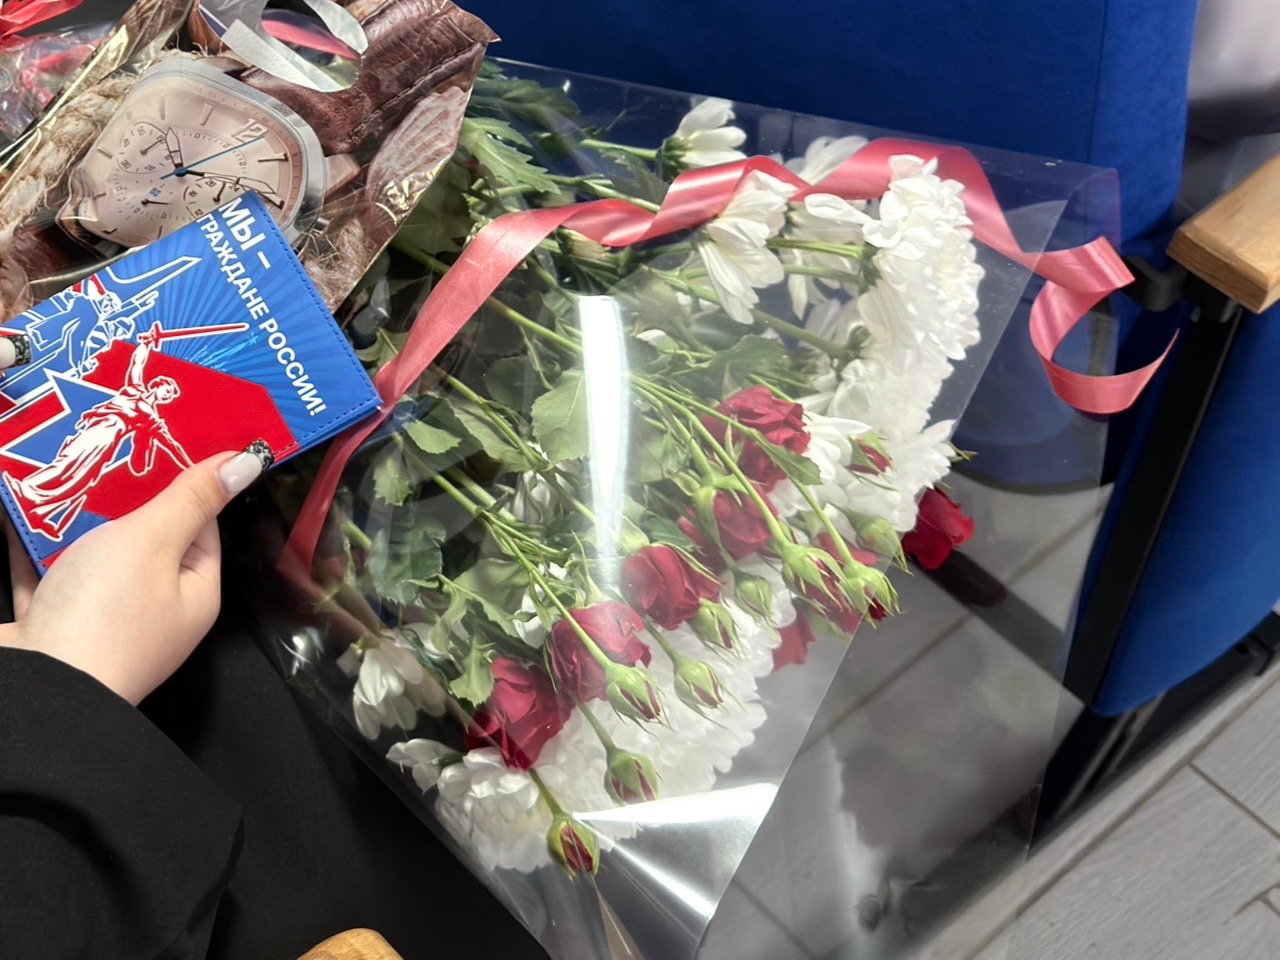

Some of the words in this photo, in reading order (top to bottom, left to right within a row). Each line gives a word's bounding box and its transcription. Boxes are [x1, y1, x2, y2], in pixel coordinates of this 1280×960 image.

[230, 117, 268, 145] 12
[218, 197, 266, 251] МЫ
[196, 213, 270, 321] ГРАЖДАНЕ
[258, 317, 327, 417] РОССИИ!
